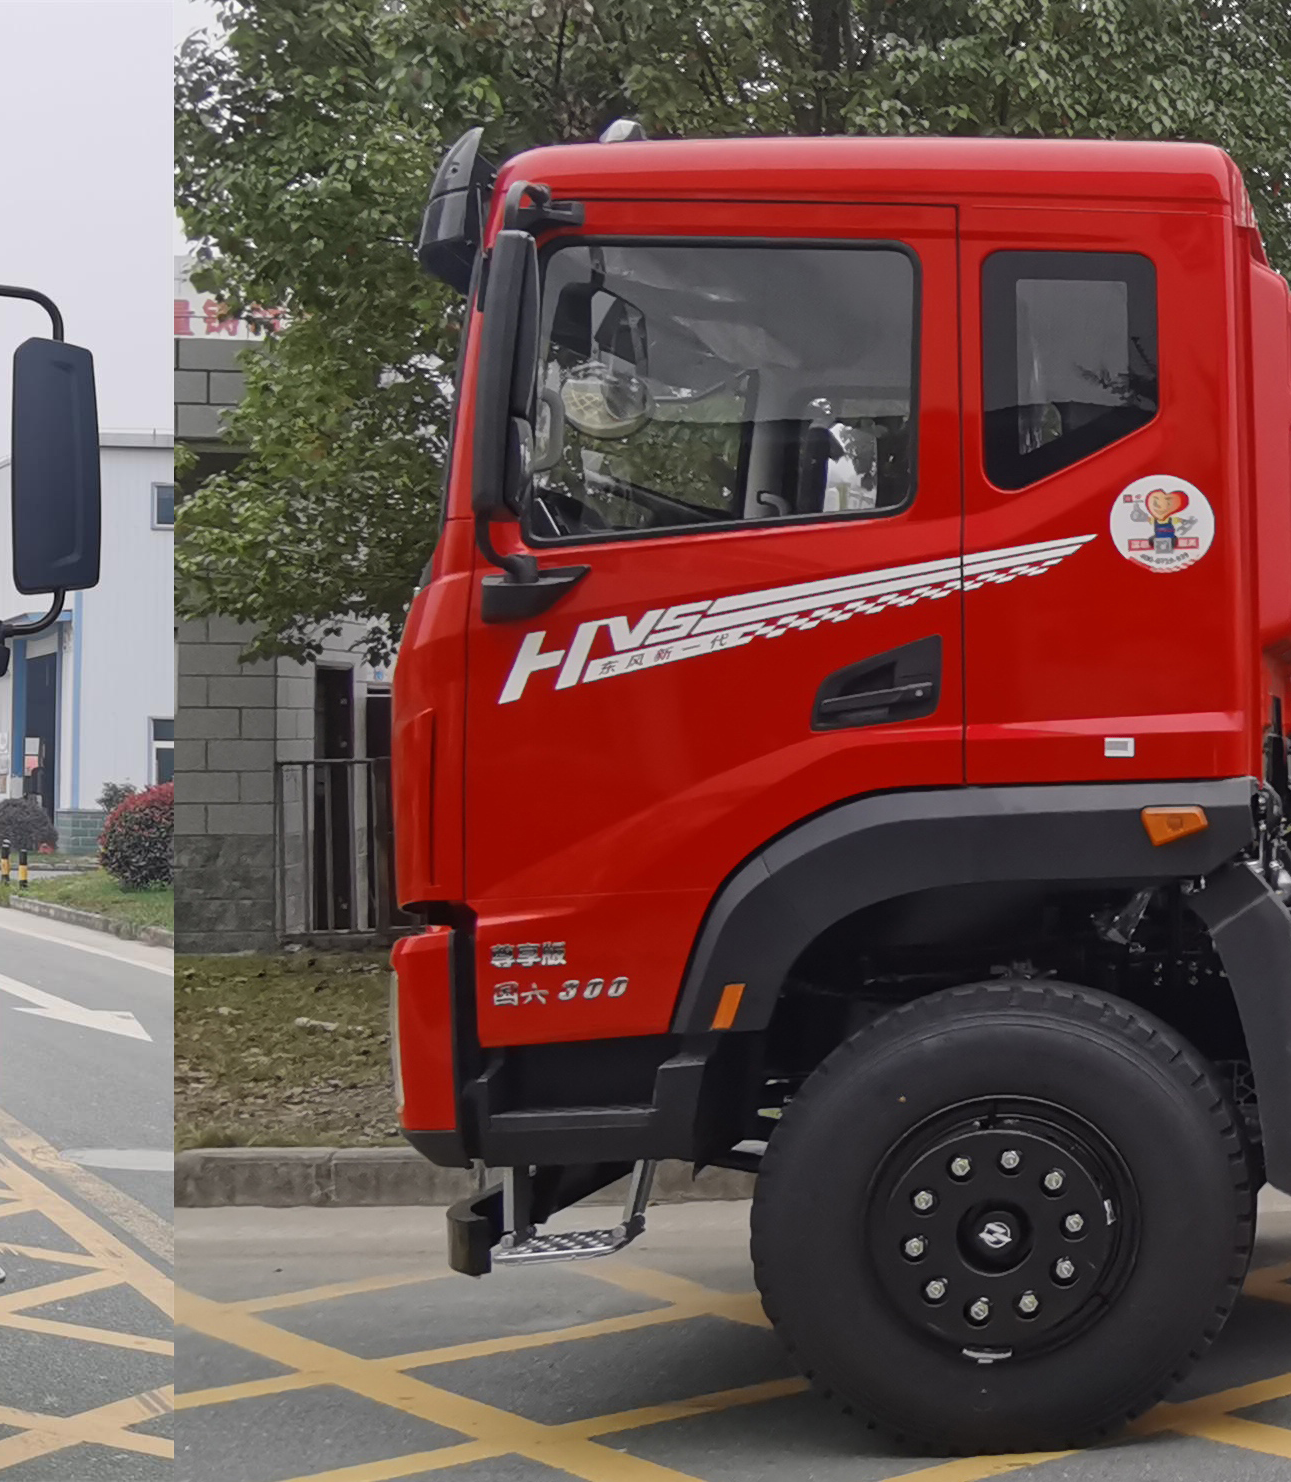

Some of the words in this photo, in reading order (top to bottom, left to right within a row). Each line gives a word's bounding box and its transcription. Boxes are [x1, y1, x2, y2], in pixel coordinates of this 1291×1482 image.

[598, 633, 729, 676] 东风新一代
[490, 941, 567, 968] 尊享版
[493, 981, 549, 1006] 国六
[558, 976, 630, 1001] 300
